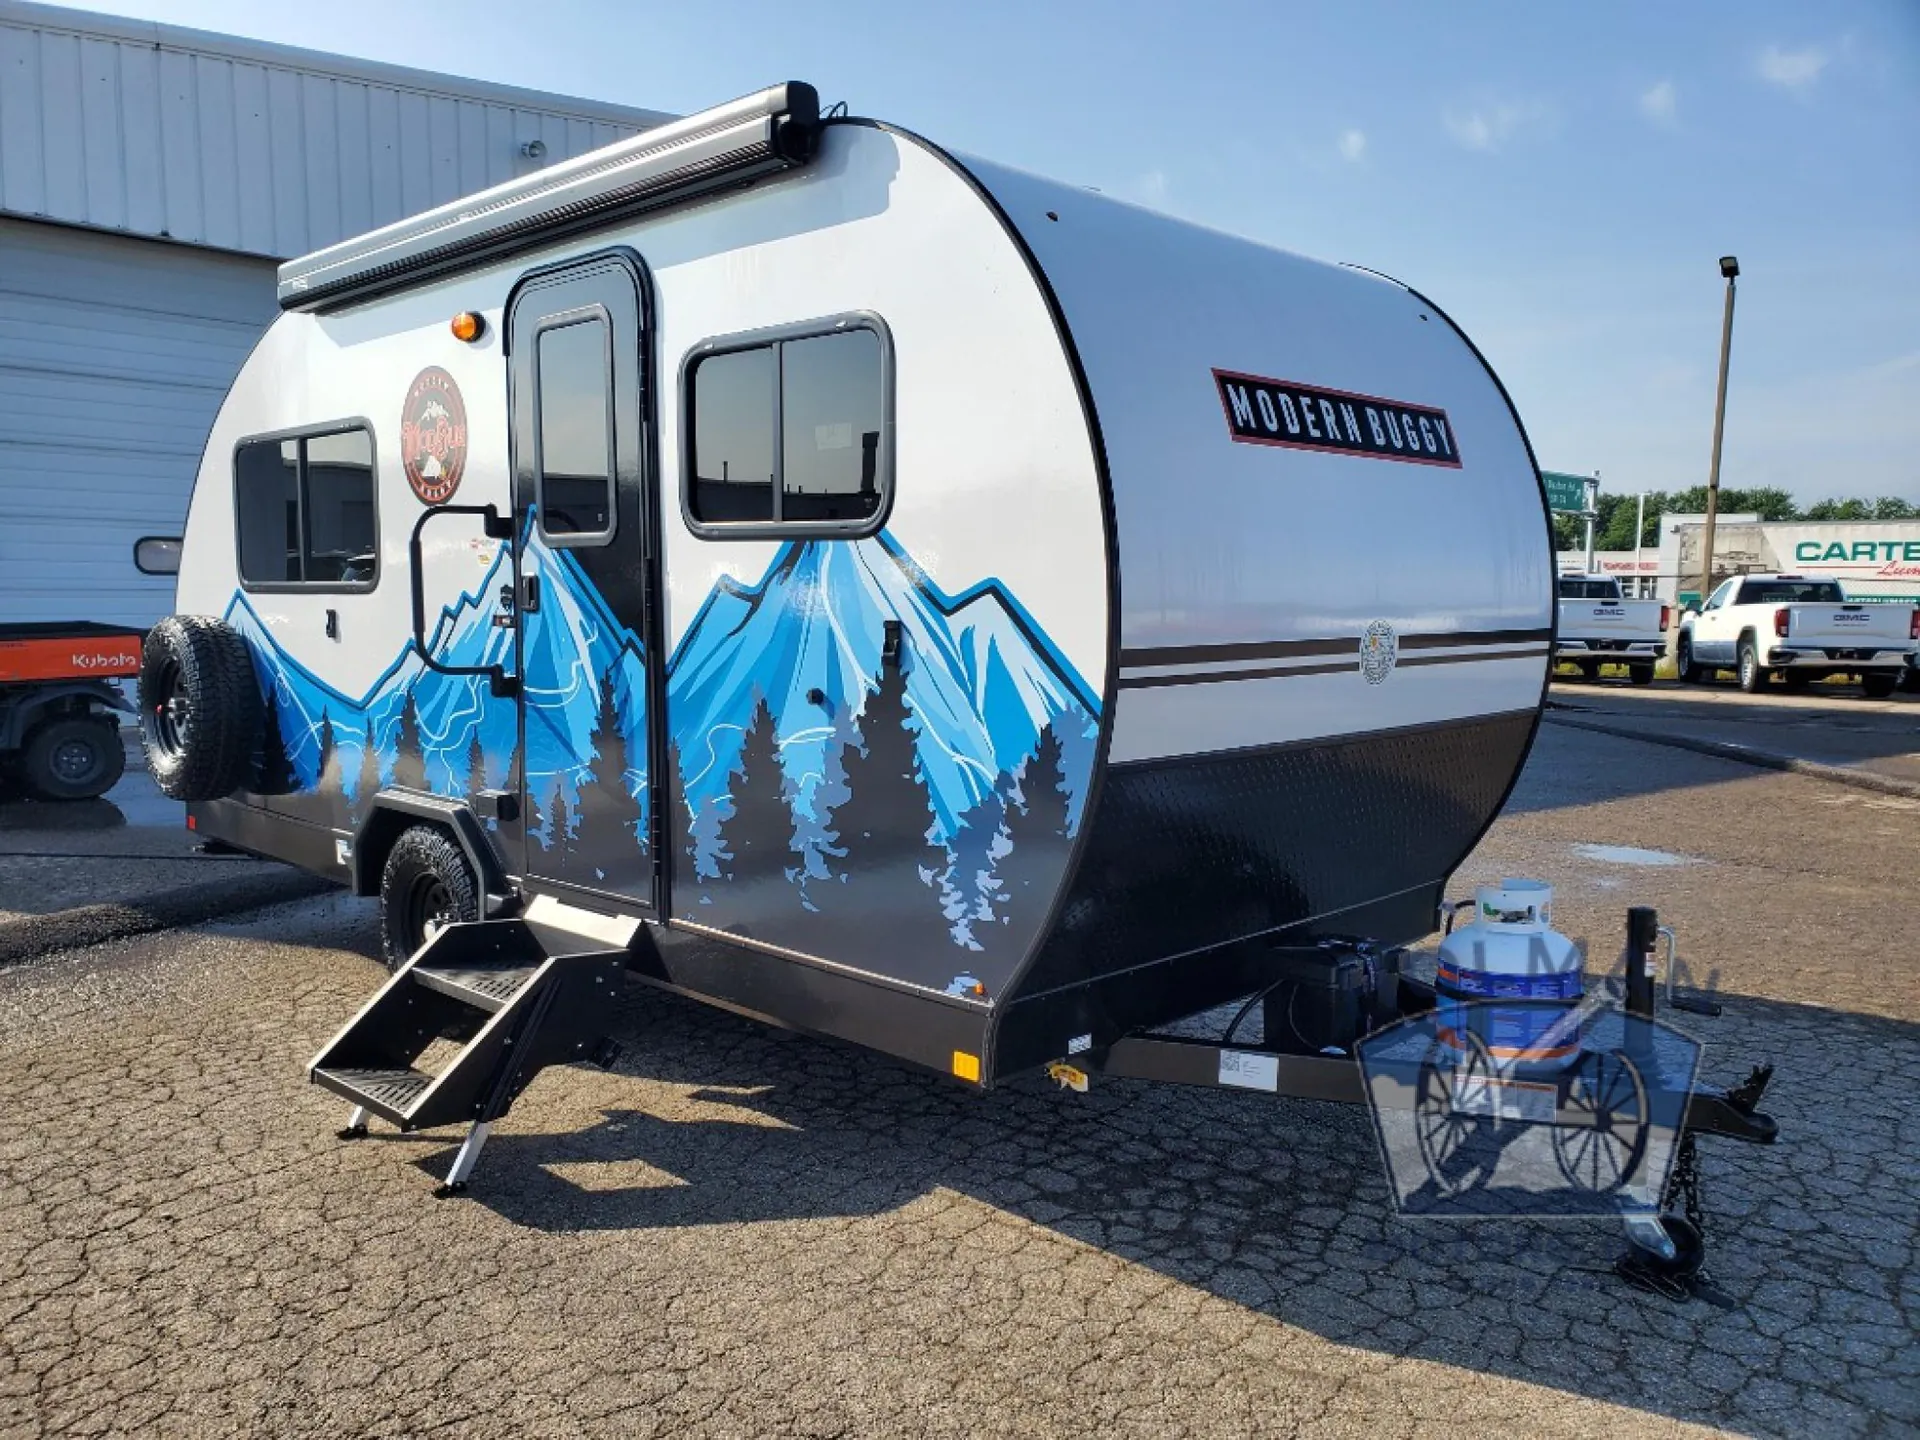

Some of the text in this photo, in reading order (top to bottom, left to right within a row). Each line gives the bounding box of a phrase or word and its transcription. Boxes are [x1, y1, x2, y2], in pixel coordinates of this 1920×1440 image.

[1226, 383, 1452, 456] MODERN BUGGY
[72, 653, 137, 668] Kubota
